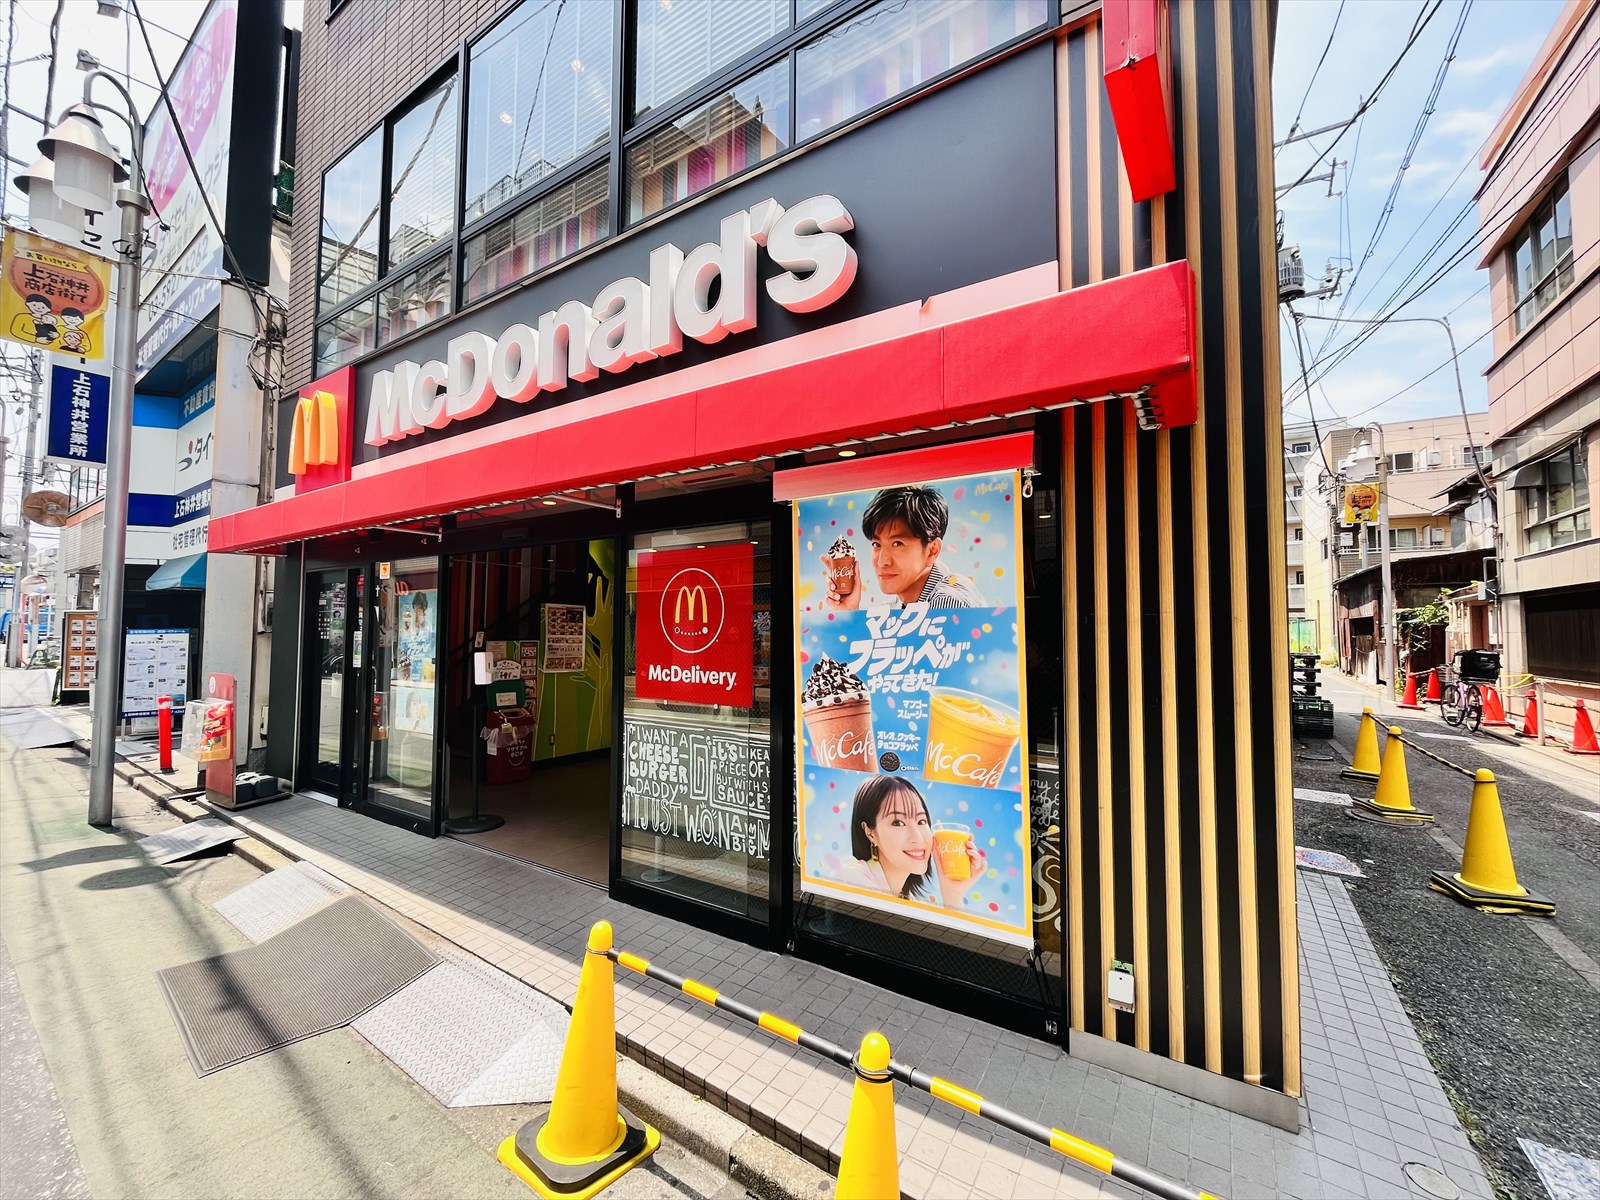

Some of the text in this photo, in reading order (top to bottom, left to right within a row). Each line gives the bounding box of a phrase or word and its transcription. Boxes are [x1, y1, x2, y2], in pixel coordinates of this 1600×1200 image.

[23, 263, 90, 293] 上石神井
[25, 277, 88, 303] 商店街で
[364, 194, 858, 446] McDonald's
[69, 372, 91, 458] 上石神井営業所
[195, 431, 214, 465] タイ
[866, 601, 947, 639] マックに
[847, 635, 970, 676] フラッペが
[648, 664, 736, 690] McDelivery
[867, 669, 939, 693] やってきた!
[897, 709, 928, 719] スムージー
[903, 699, 928, 709] マンゴー
[642, 727, 678, 746] WANT
[679, 732, 688, 748] A
[816, 728, 874, 768] McCafé
[877, 740, 919, 752] チョコフラッペ
[629, 761, 688, 783] BURGER
[926, 740, 1004, 788] McCafé
[717, 774, 732, 786] BUT
[640, 796, 682, 837] JUST
[684, 805, 730, 850] WON
